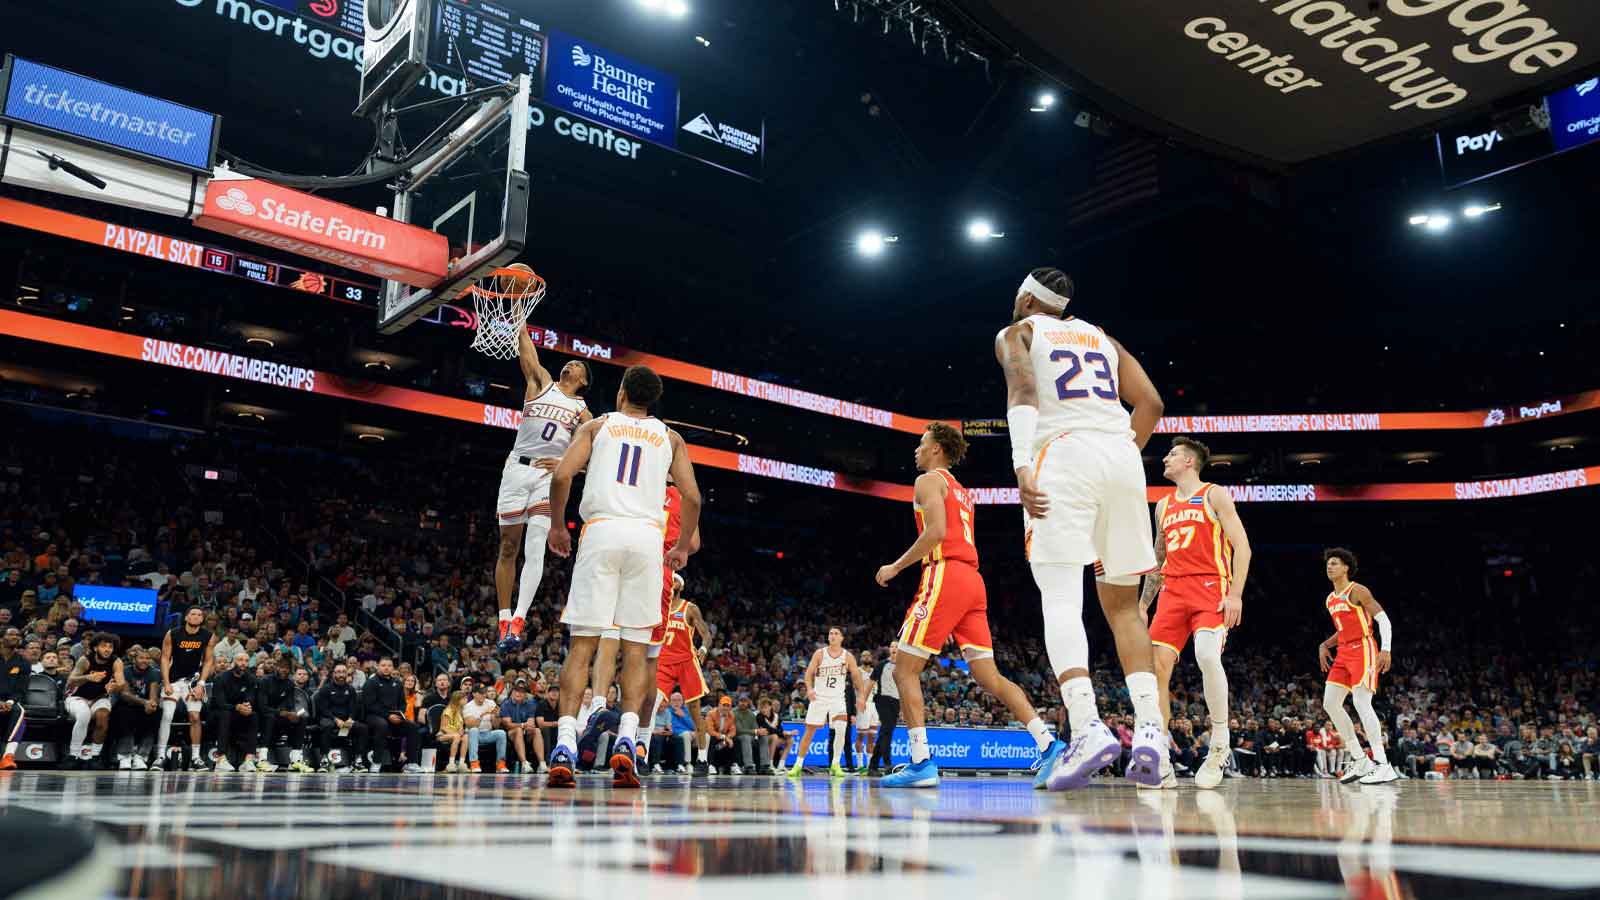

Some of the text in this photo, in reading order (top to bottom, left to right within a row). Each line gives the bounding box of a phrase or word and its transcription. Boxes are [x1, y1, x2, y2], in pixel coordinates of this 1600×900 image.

[1184, 17, 1323, 93] center
[593, 55, 655, 93] Banner
[592, 72, 649, 109] Health
[24, 81, 196, 146] ticketmaster
[557, 84, 664, 130] Official Health Care Partner
[573, 100, 651, 134] of the Phoenix Suns
[554, 116, 642, 159] center
[719, 123, 760, 145] MOUNTAIN
[721, 133, 757, 152] AMERICA
[103, 223, 164, 259] PAYPAL
[211, 255, 222, 266] 15
[238, 259, 267, 272] TIMEOUTS
[247, 270, 266, 281] FOULS
[346, 286, 362, 300] 33
[572, 339, 611, 359] PayPal
[142, 338, 314, 391] SUNS.COM/MEMBERSHIPS
[1049, 350, 1117, 400] 23
[711, 369, 744, 395] PAYPAL
[1520, 400, 1561, 418] PayPal
[540, 422, 557, 441] 0
[1192, 416, 1242, 432] SIXTHMAN
[1243, 415, 1308, 432] MEMBERSHIPS
[1310, 414, 1325, 431] ON
[1326, 413, 1351, 431] SALE
[1352, 413, 1379, 430] NOW!
[616, 442, 642, 487] 11
[738, 454, 836, 488] SUNS.COM/MEMBERSHIPS
[1455, 468, 1586, 500] SUNS.COM/MEMBERSHIPS
[1167, 526, 1196, 552] 27
[179, 640, 202, 649] SUNS
[826, 676, 837, 688] 12
